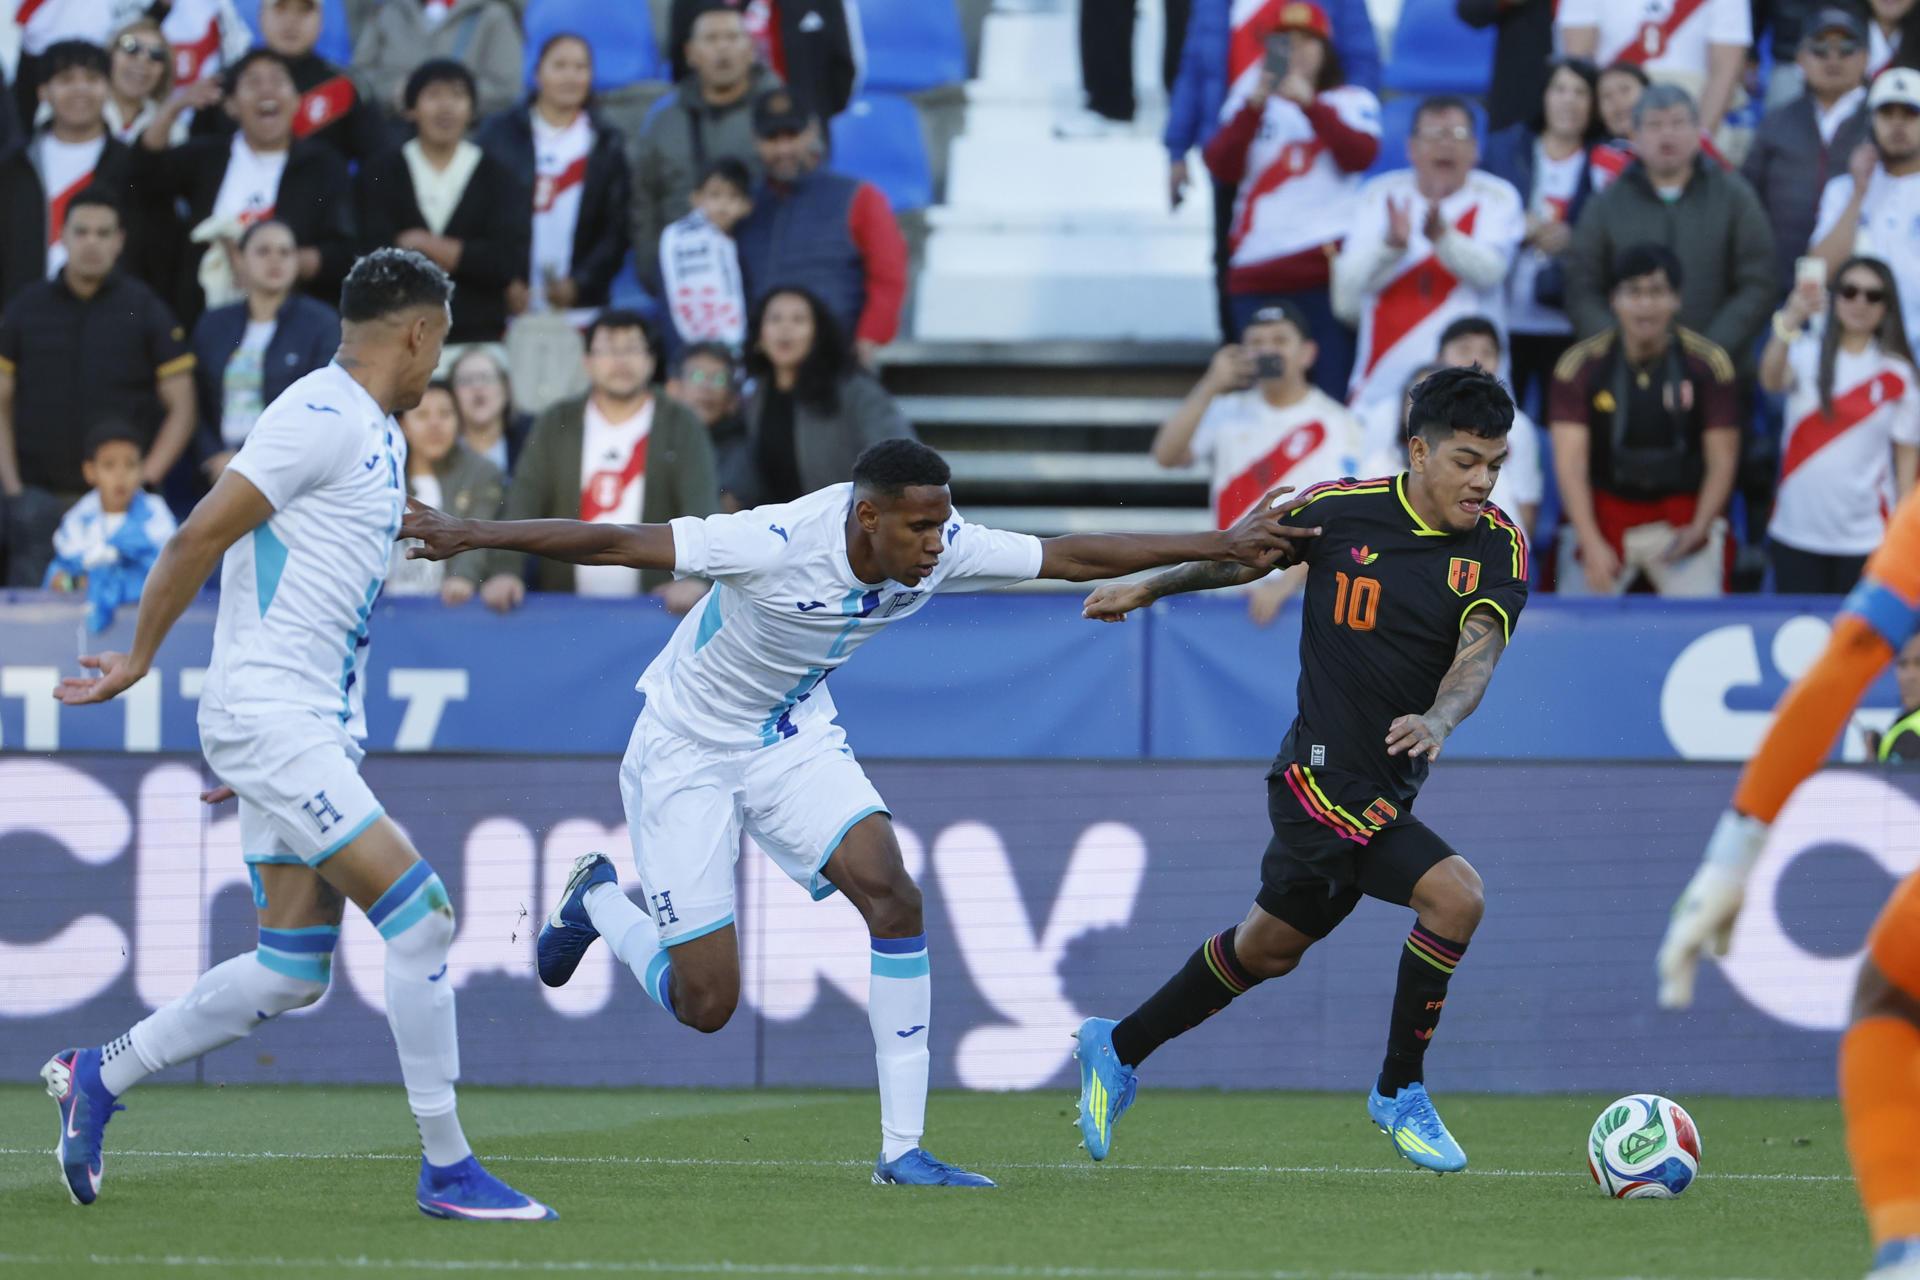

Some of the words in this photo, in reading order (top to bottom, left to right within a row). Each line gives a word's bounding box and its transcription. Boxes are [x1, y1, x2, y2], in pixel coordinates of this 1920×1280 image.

[1453, 570, 1475, 580] FPF
[1334, 571, 1382, 631] 10
[302, 790, 343, 833] H
[651, 890, 679, 927] H
